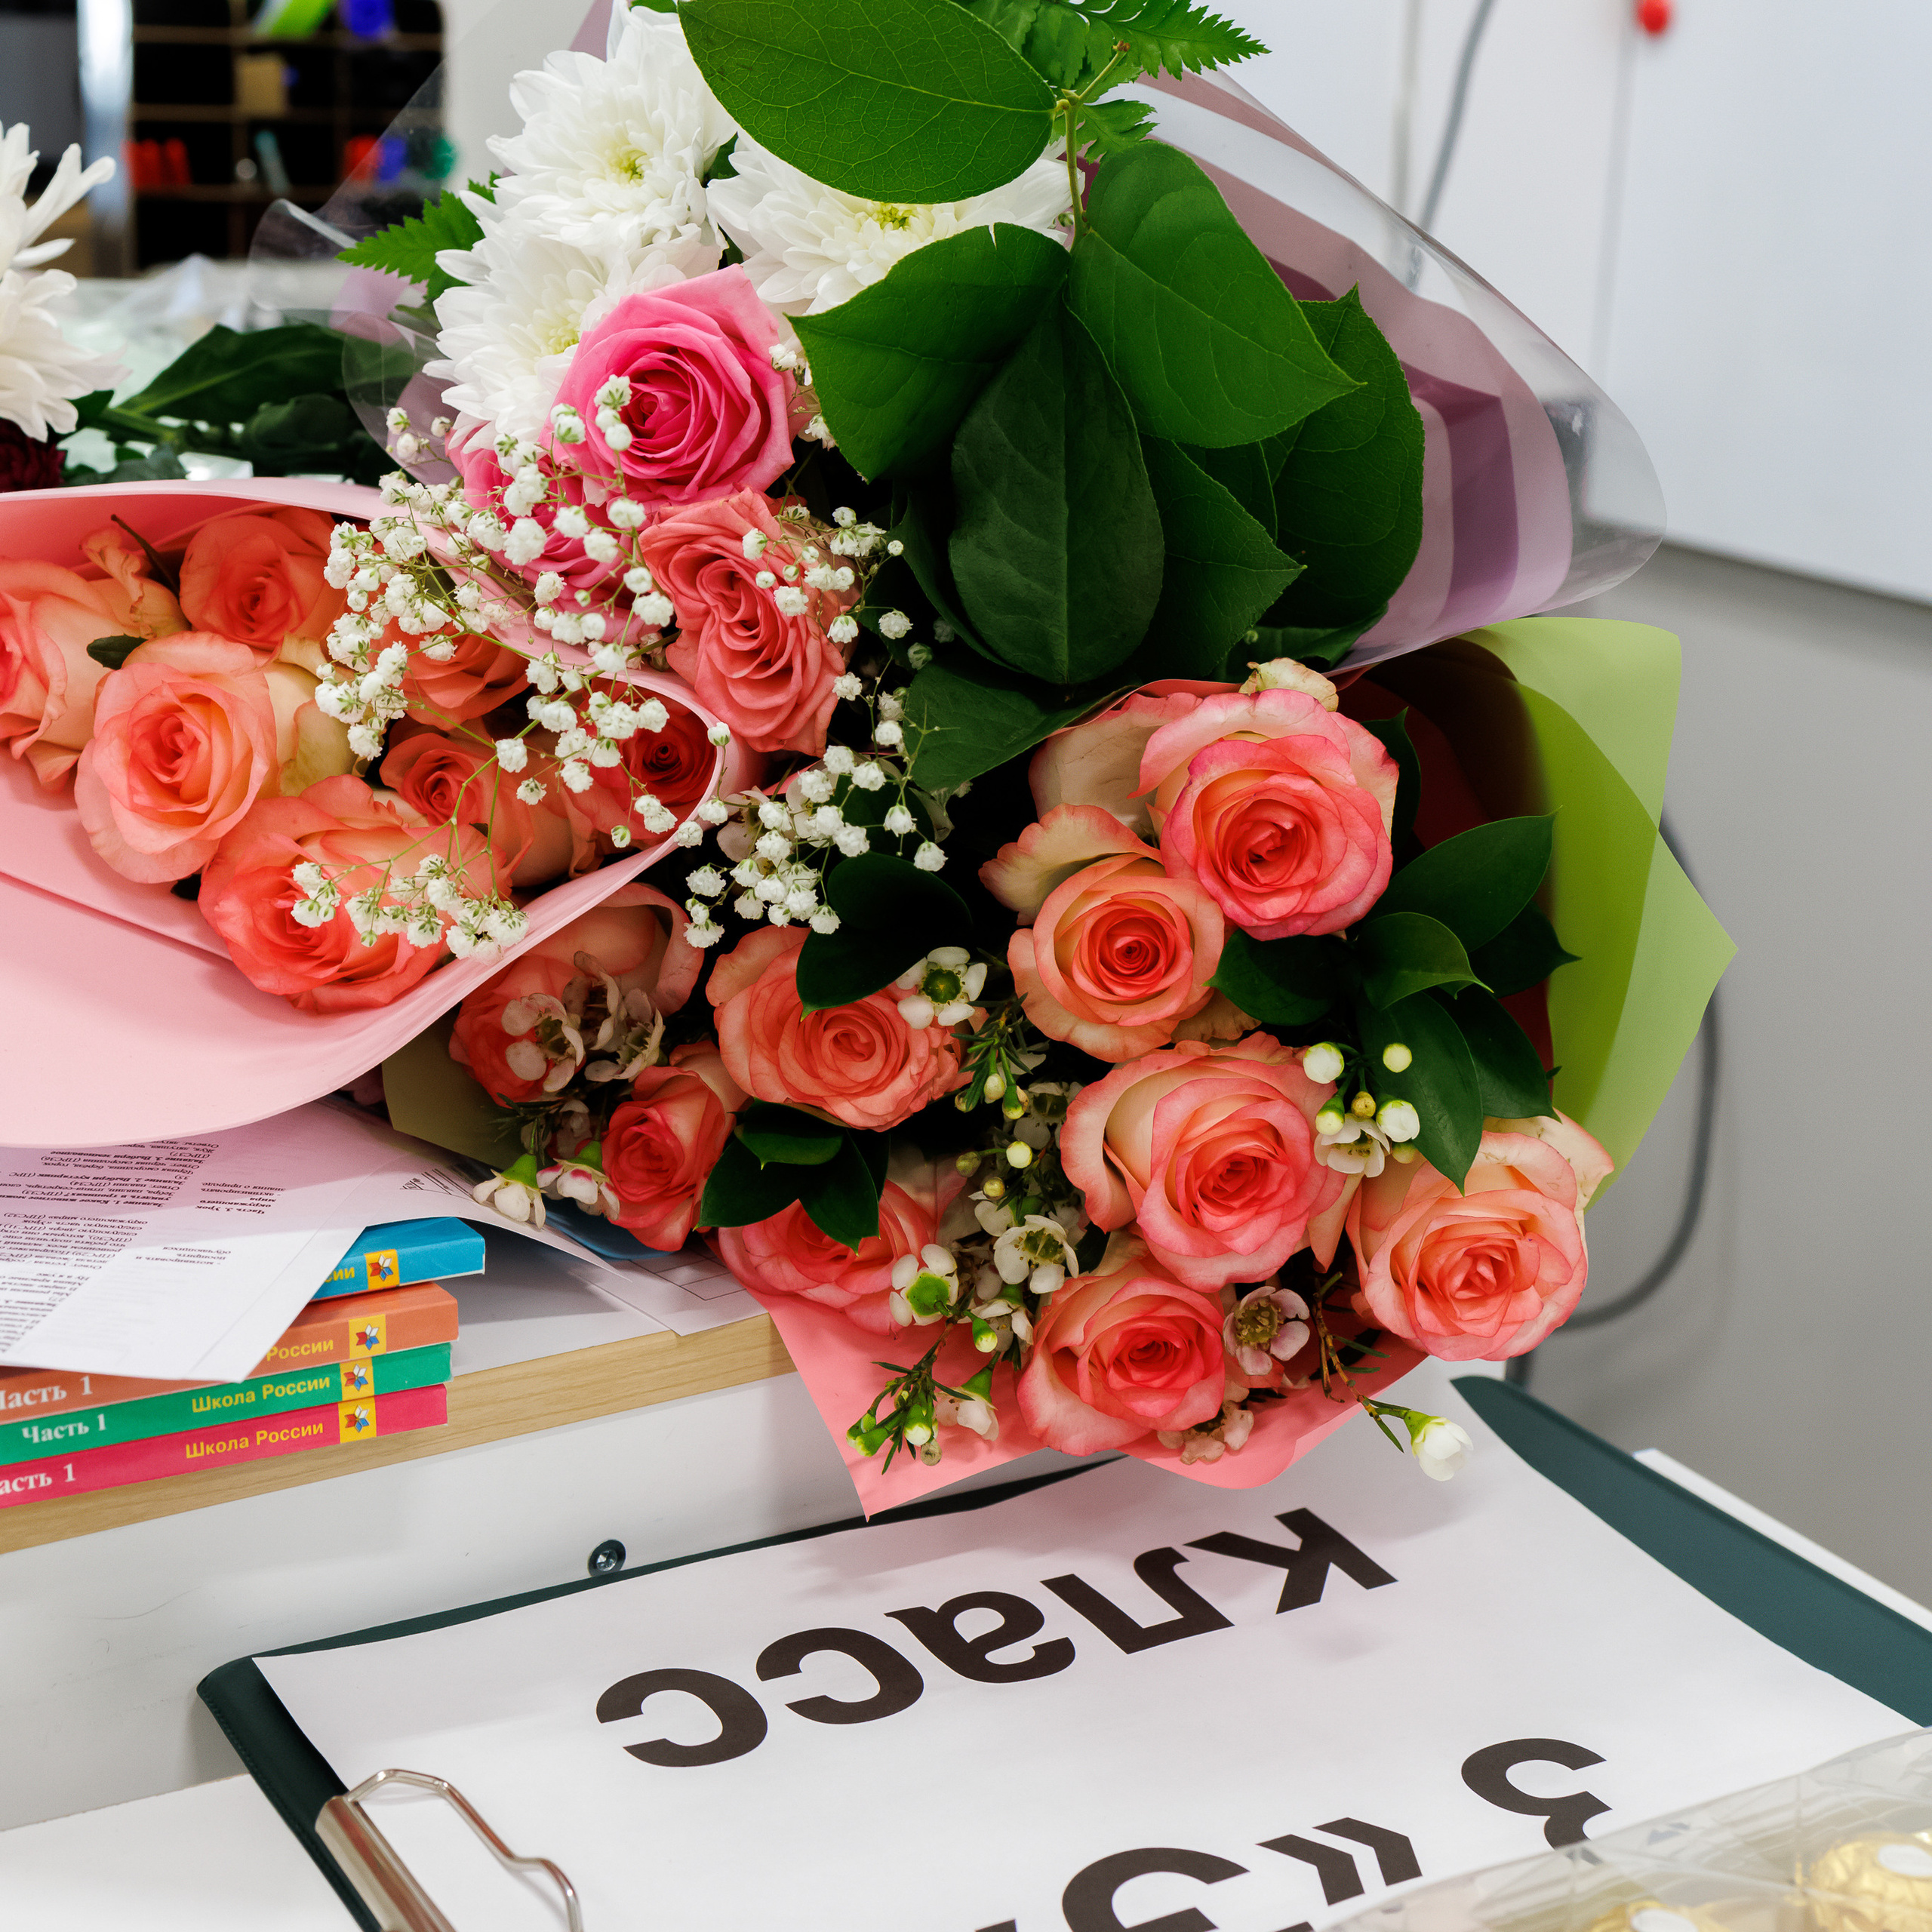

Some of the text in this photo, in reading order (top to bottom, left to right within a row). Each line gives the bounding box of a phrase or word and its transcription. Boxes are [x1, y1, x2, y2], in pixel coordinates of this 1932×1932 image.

[201, 1188, 275, 1196] активизировать
[145, 1257, 214, 1265] мотивировать
[266, 1340, 334, 1361] России
[80, 1375, 94, 1395] 1
[192, 1377, 331, 1413] Школа России
[21, 1414, 106, 1444] Часть 1
[185, 1423, 324, 1459] Школа России
[63, 1463, 75, 1482] 1
[596, 1507, 1399, 1767] класс
